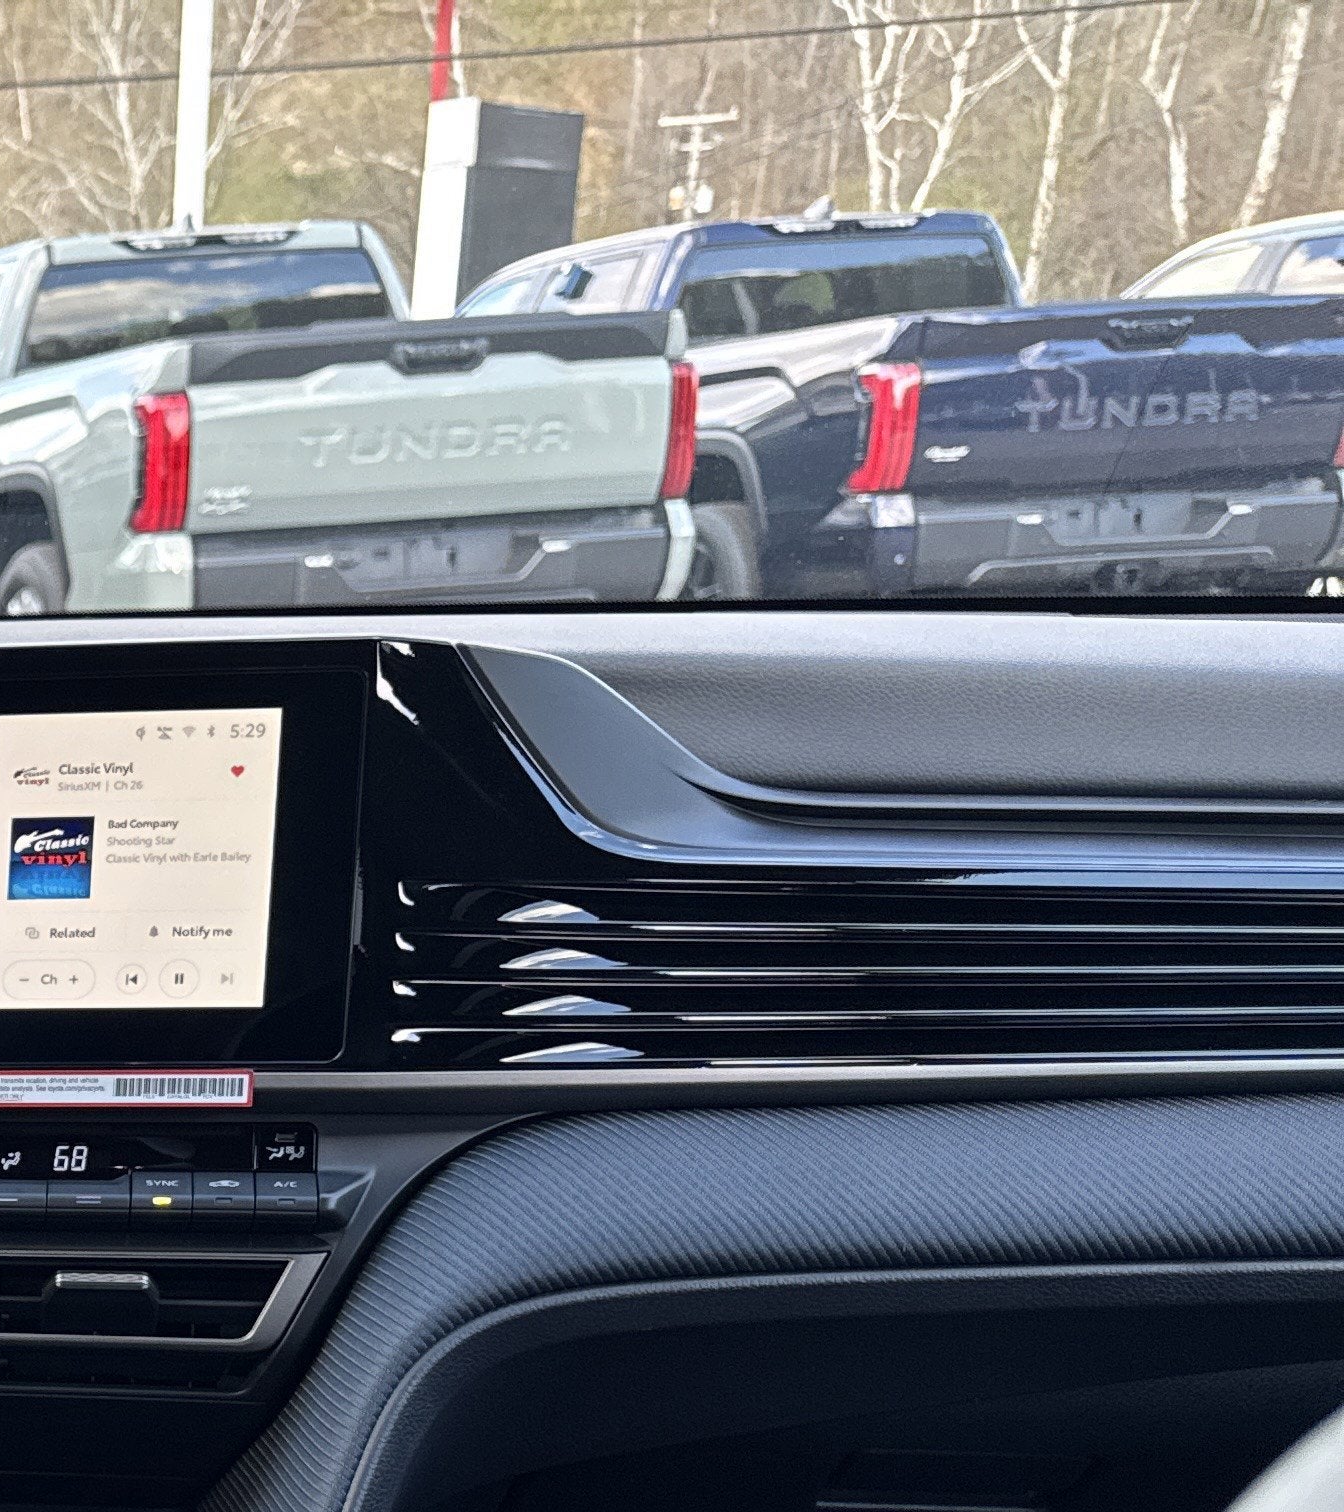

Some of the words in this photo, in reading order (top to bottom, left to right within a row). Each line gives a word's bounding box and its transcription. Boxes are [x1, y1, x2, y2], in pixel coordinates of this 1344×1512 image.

[1013, 388, 1263, 433] TUNDRA
[297, 413, 573, 469] TUNDRA
[229, 723, 267, 739] 5:29
[58, 762, 101, 775] Classic
[103, 761, 134, 775] Vinyl
[57, 780, 101, 792] SiriusXM
[113, 780, 128, 791] Ch
[129, 779, 144, 791] 26
[107, 819, 128, 829] Bad
[129, 818, 179, 830] Company
[33, 833, 90, 852] Classic
[106, 836, 154, 848] Shooting
[156, 835, 176, 846] Star
[20, 850, 88, 868] vinyl
[105, 853, 141, 865] Classic
[143, 852, 167, 865] Vinyl
[168, 852, 191, 863] with
[220, 851, 252, 864] Bailey
[49, 926, 96, 939] Related
[172, 925, 210, 939] Notify
[212, 927, 233, 937] me
[40, 973, 58, 986] Ch
[52, 1144, 89, 1172] 68
[145, 1179, 179, 1188] SYNC
[273, 1180, 298, 1188] A/C
